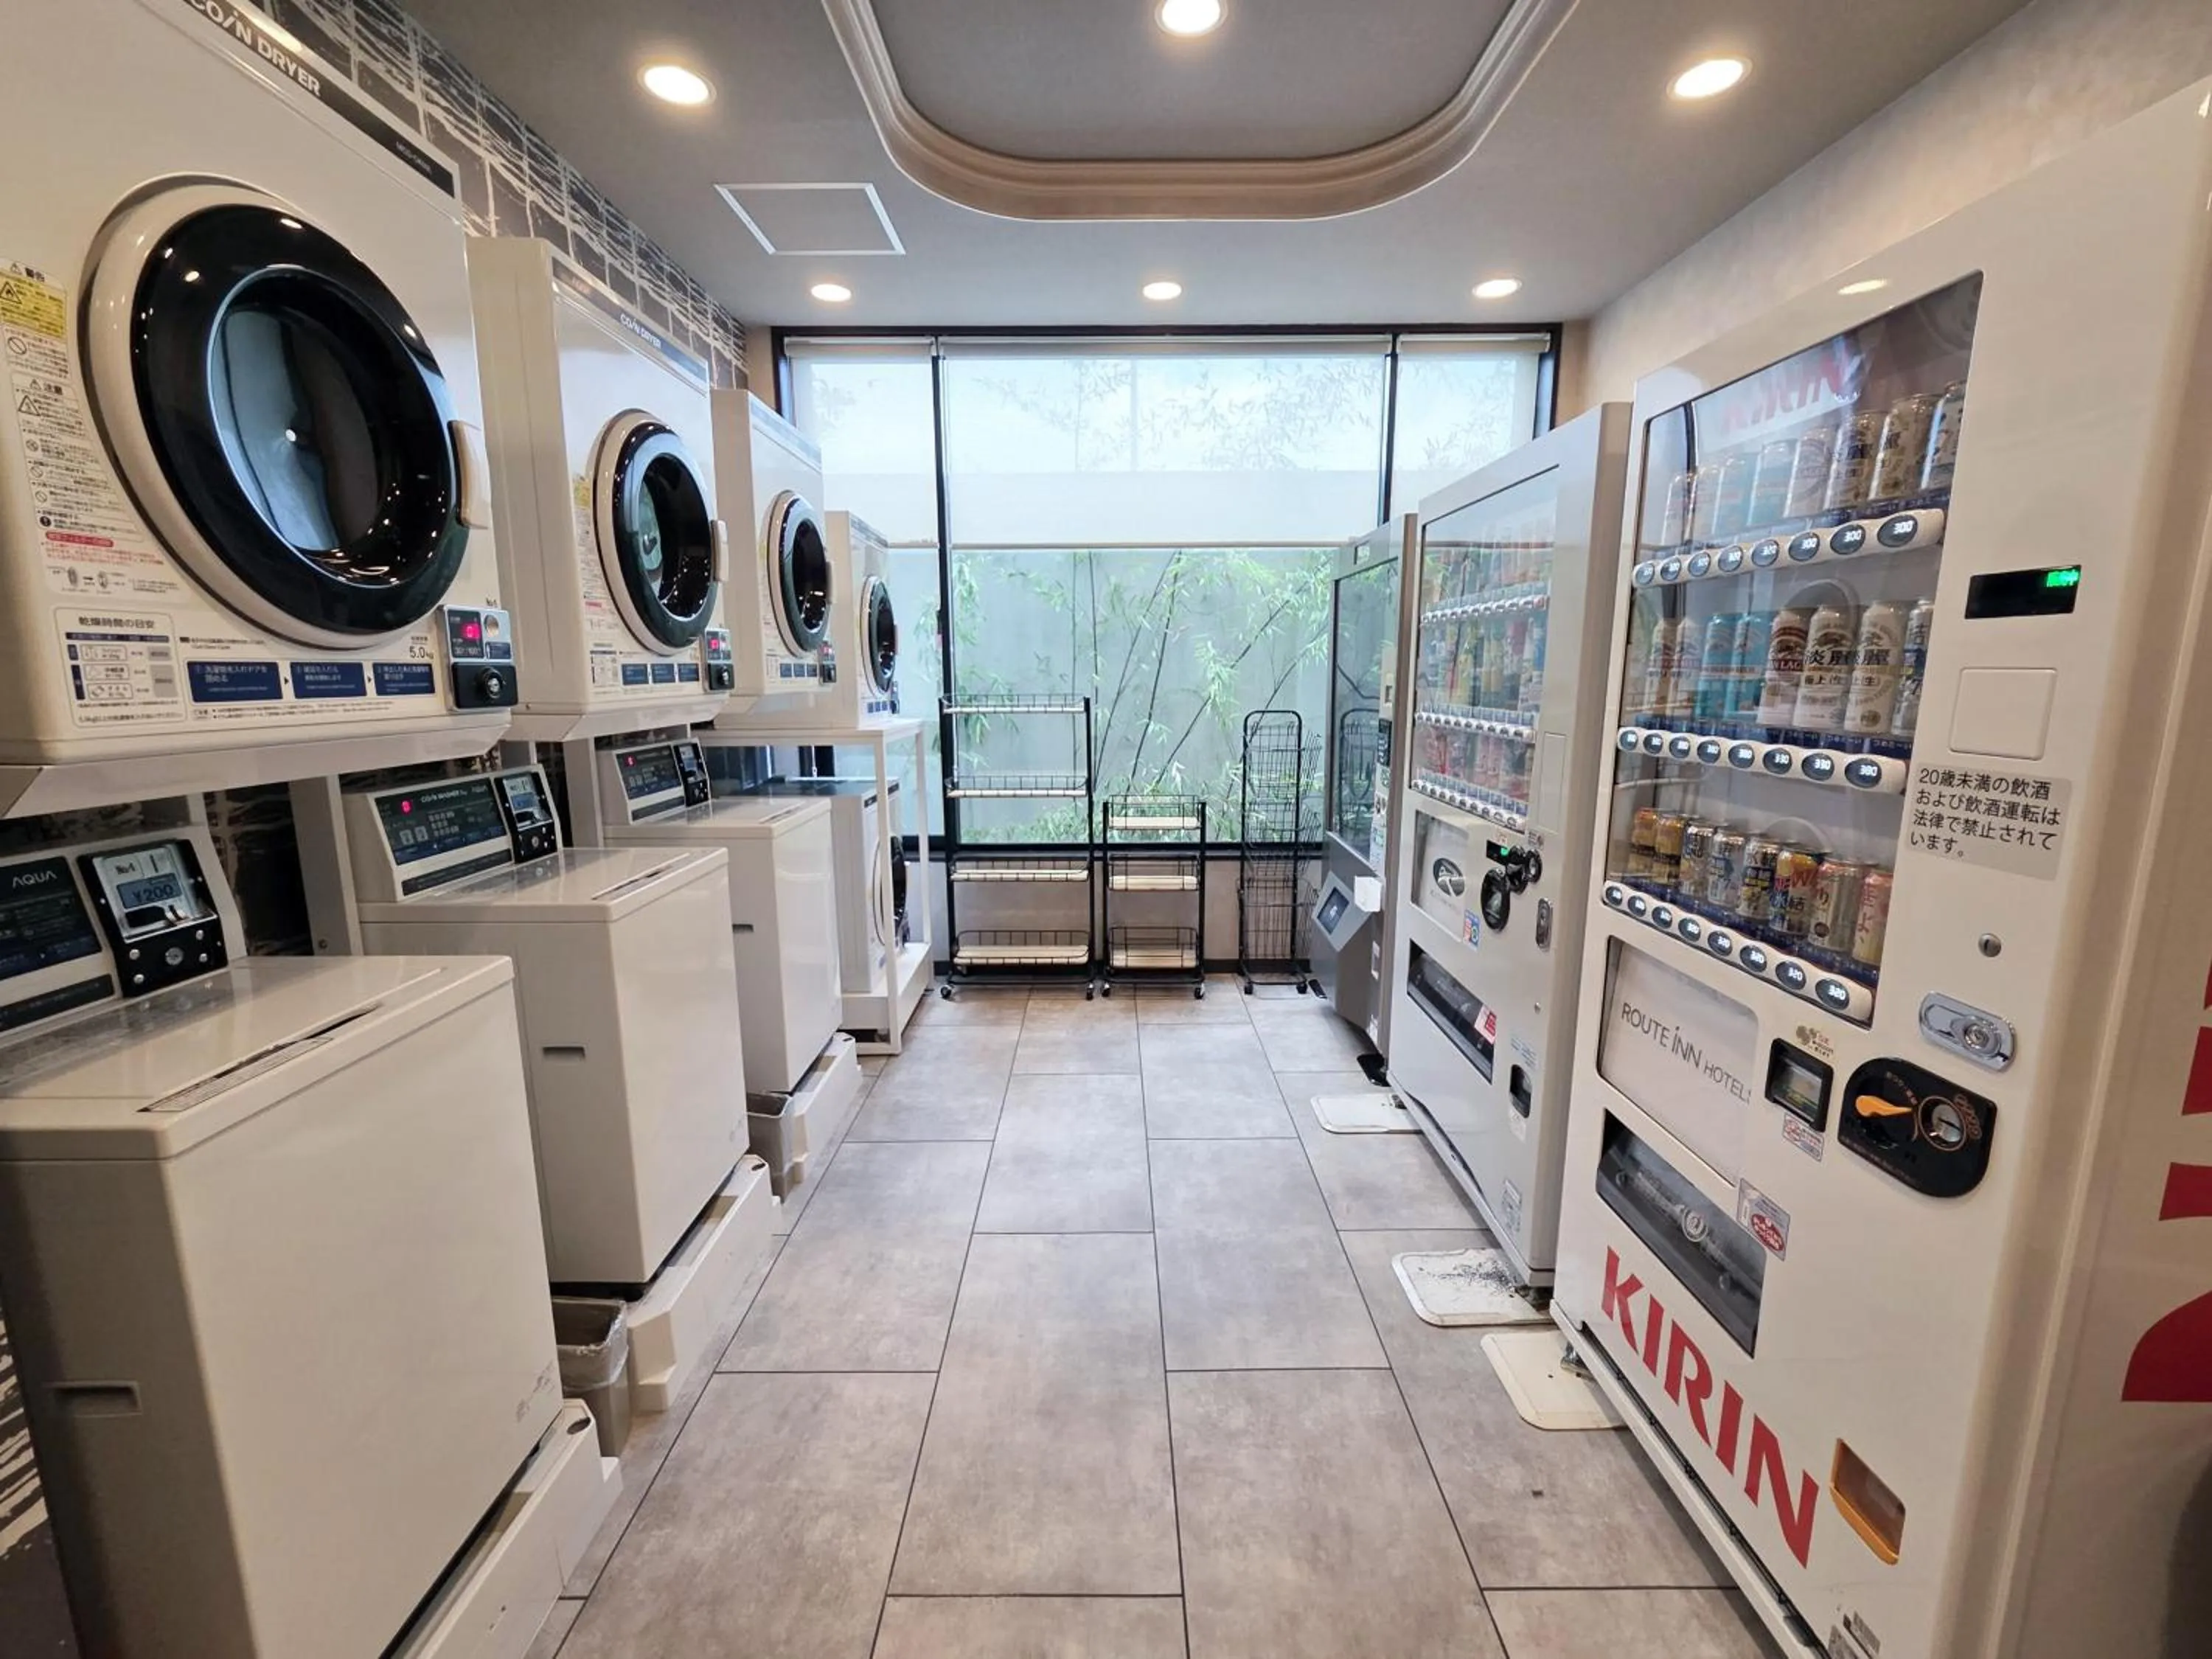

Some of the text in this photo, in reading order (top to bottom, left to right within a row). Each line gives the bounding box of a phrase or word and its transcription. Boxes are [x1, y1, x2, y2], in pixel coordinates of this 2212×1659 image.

[257, 36, 321, 97] DRYER
[1844, 529, 1862, 542] 300
[1893, 521, 1915, 535] 300
[1815, 759, 1832, 771] 330
[1919, 768, 2052, 800] 20歳未満の飲酒
[1916, 788, 2061, 826] および飲酒運転は
[1910, 831, 1964, 858] います。
[1913, 808, 2057, 850] 法律で禁止されて
[12, 870, 57, 888] AQUA
[1828, 984, 1846, 1001] 320
[1621, 1002, 1670, 1048] ROUTE
[1601, 1245, 1820, 1570] KIRIN
